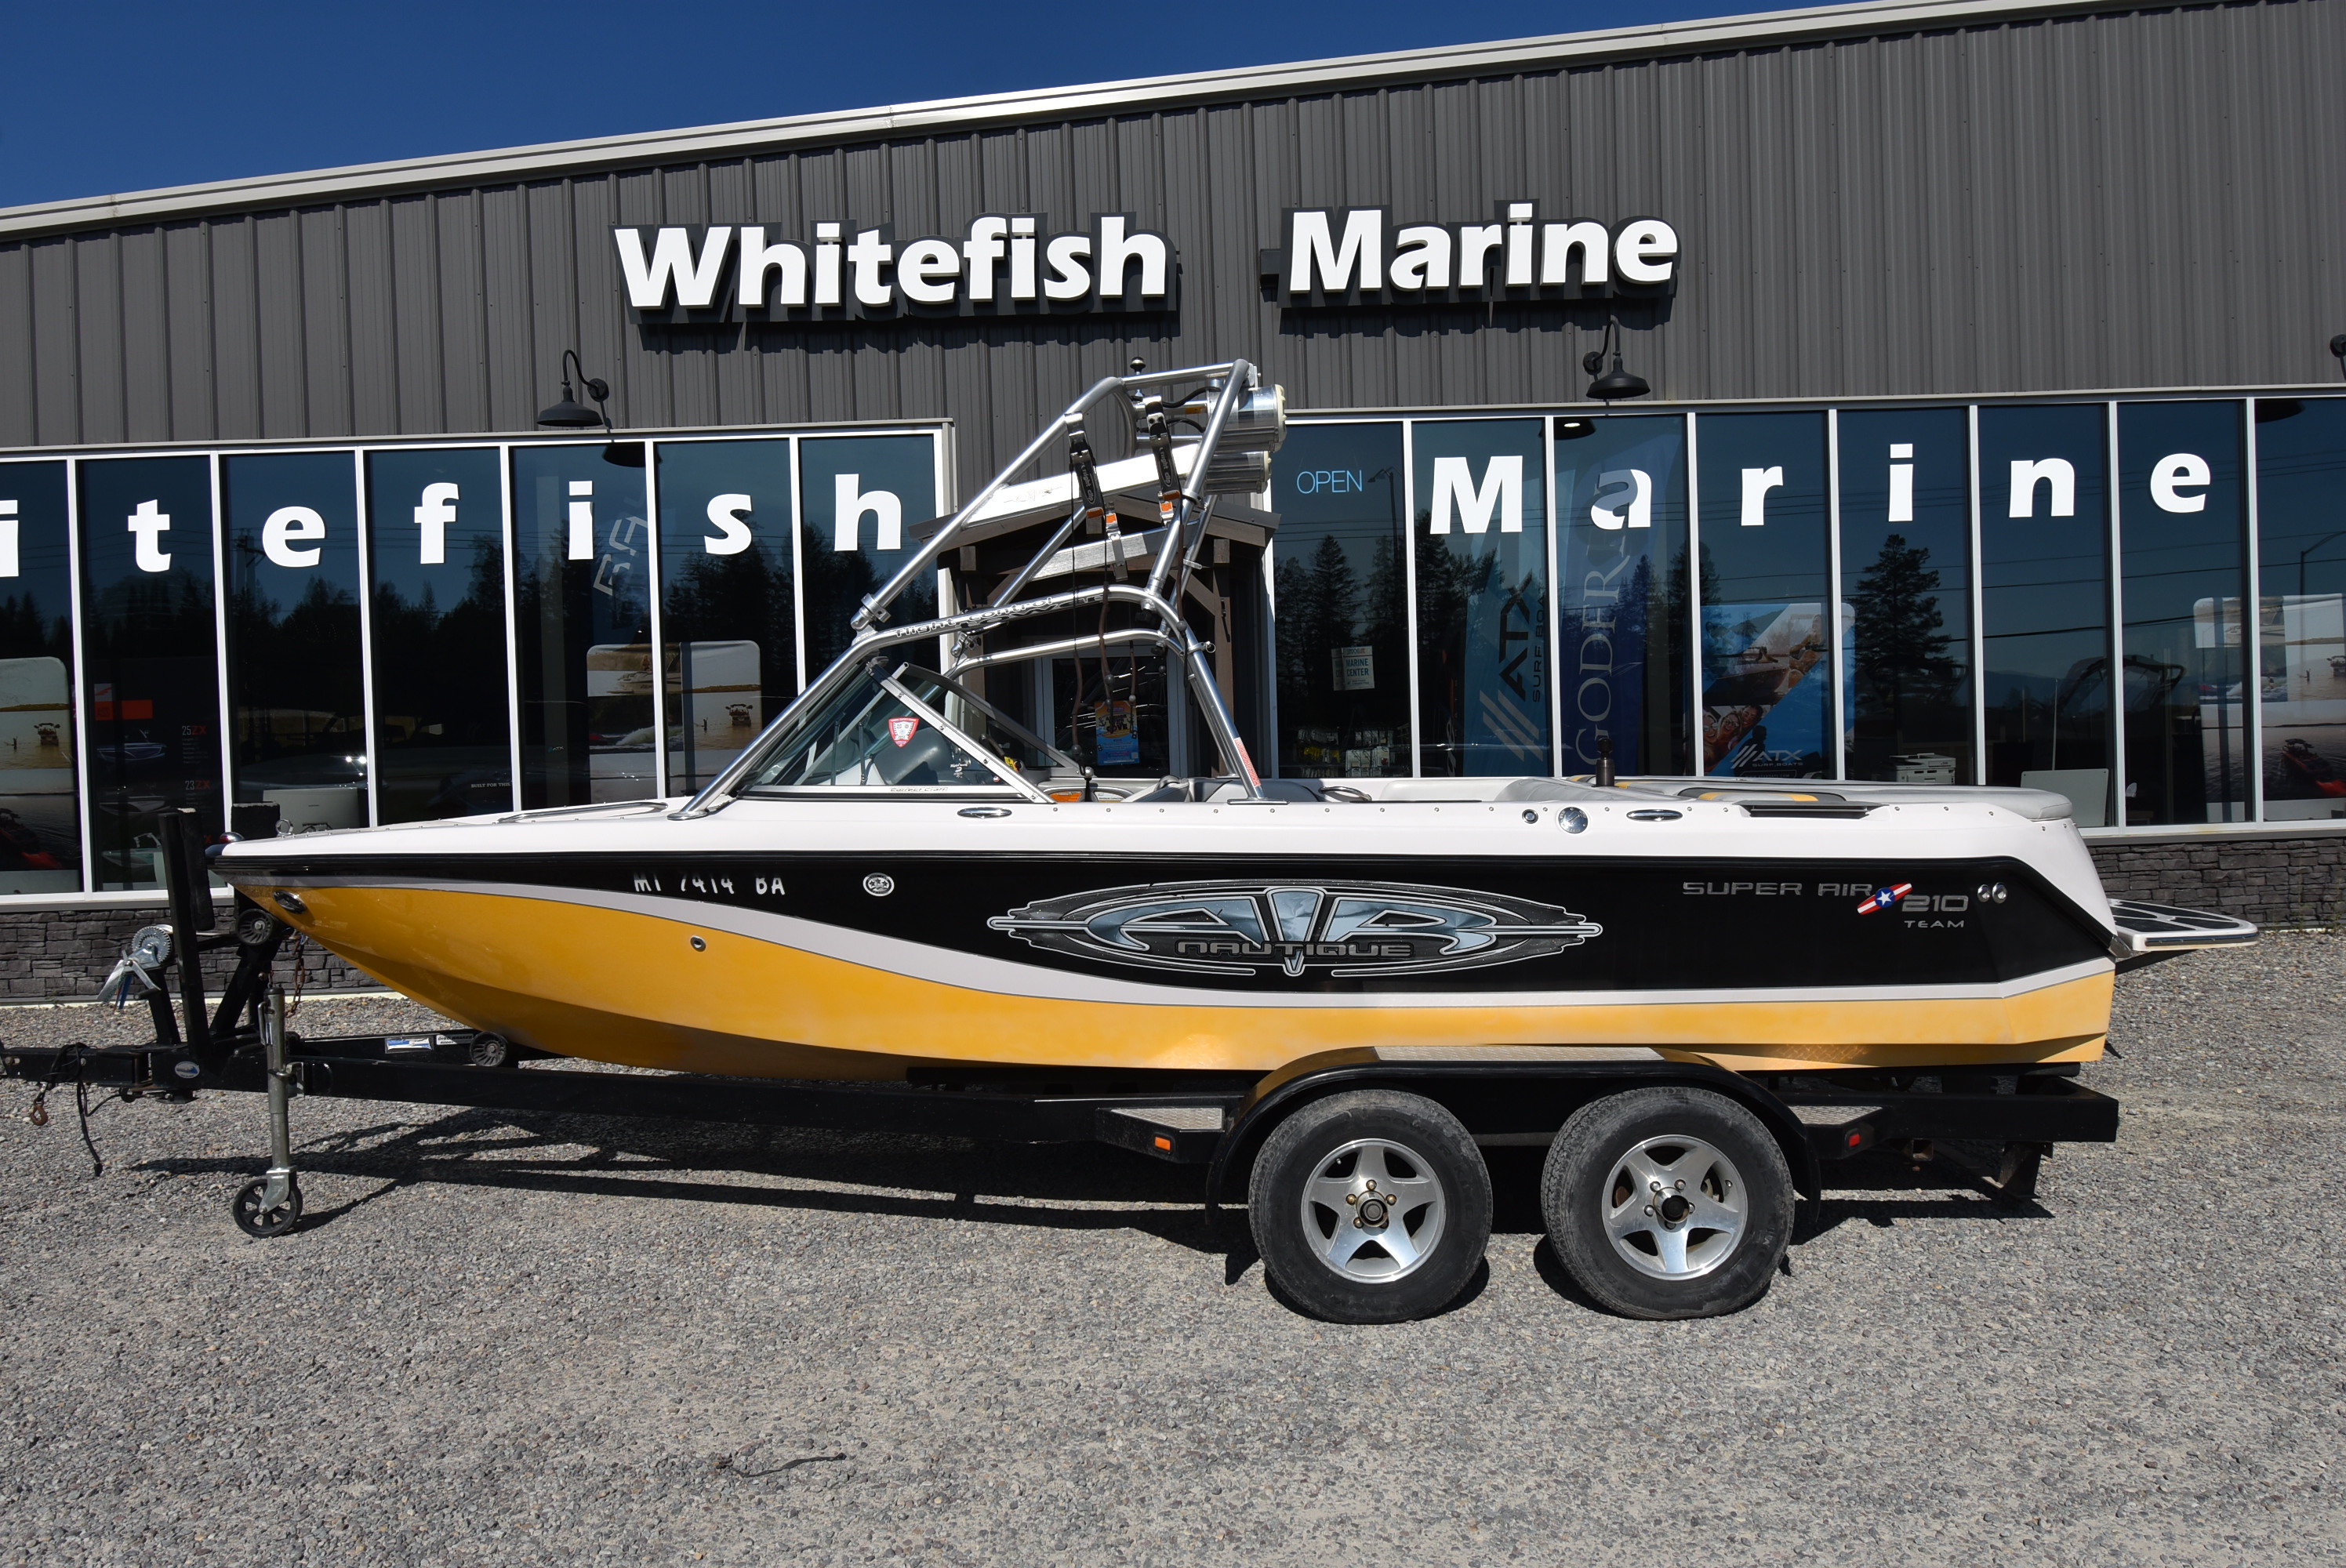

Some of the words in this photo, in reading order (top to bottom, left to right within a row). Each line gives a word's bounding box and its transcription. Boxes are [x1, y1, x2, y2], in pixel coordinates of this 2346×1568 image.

[614, 216, 1166, 307] Whitefish
[1290, 203, 1678, 291] Marine
[1296, 470, 1363, 494] OPEN
[895, 618, 957, 637] flight
[968, 597, 1053, 622] control
[1498, 568, 1533, 702] ATX
[1346, 659, 1370, 667] MARINE
[1346, 668, 1370, 677] CENTER
[1531, 645, 1543, 702] SURF
[1752, 749, 1803, 762] ATX
[754, 873, 786, 895] BA
[1683, 881, 1803, 896] SUPER
[1818, 882, 1873, 897] AIR
[1901, 894, 1969, 912] 210
[1903, 920, 1965, 928] TEAM
